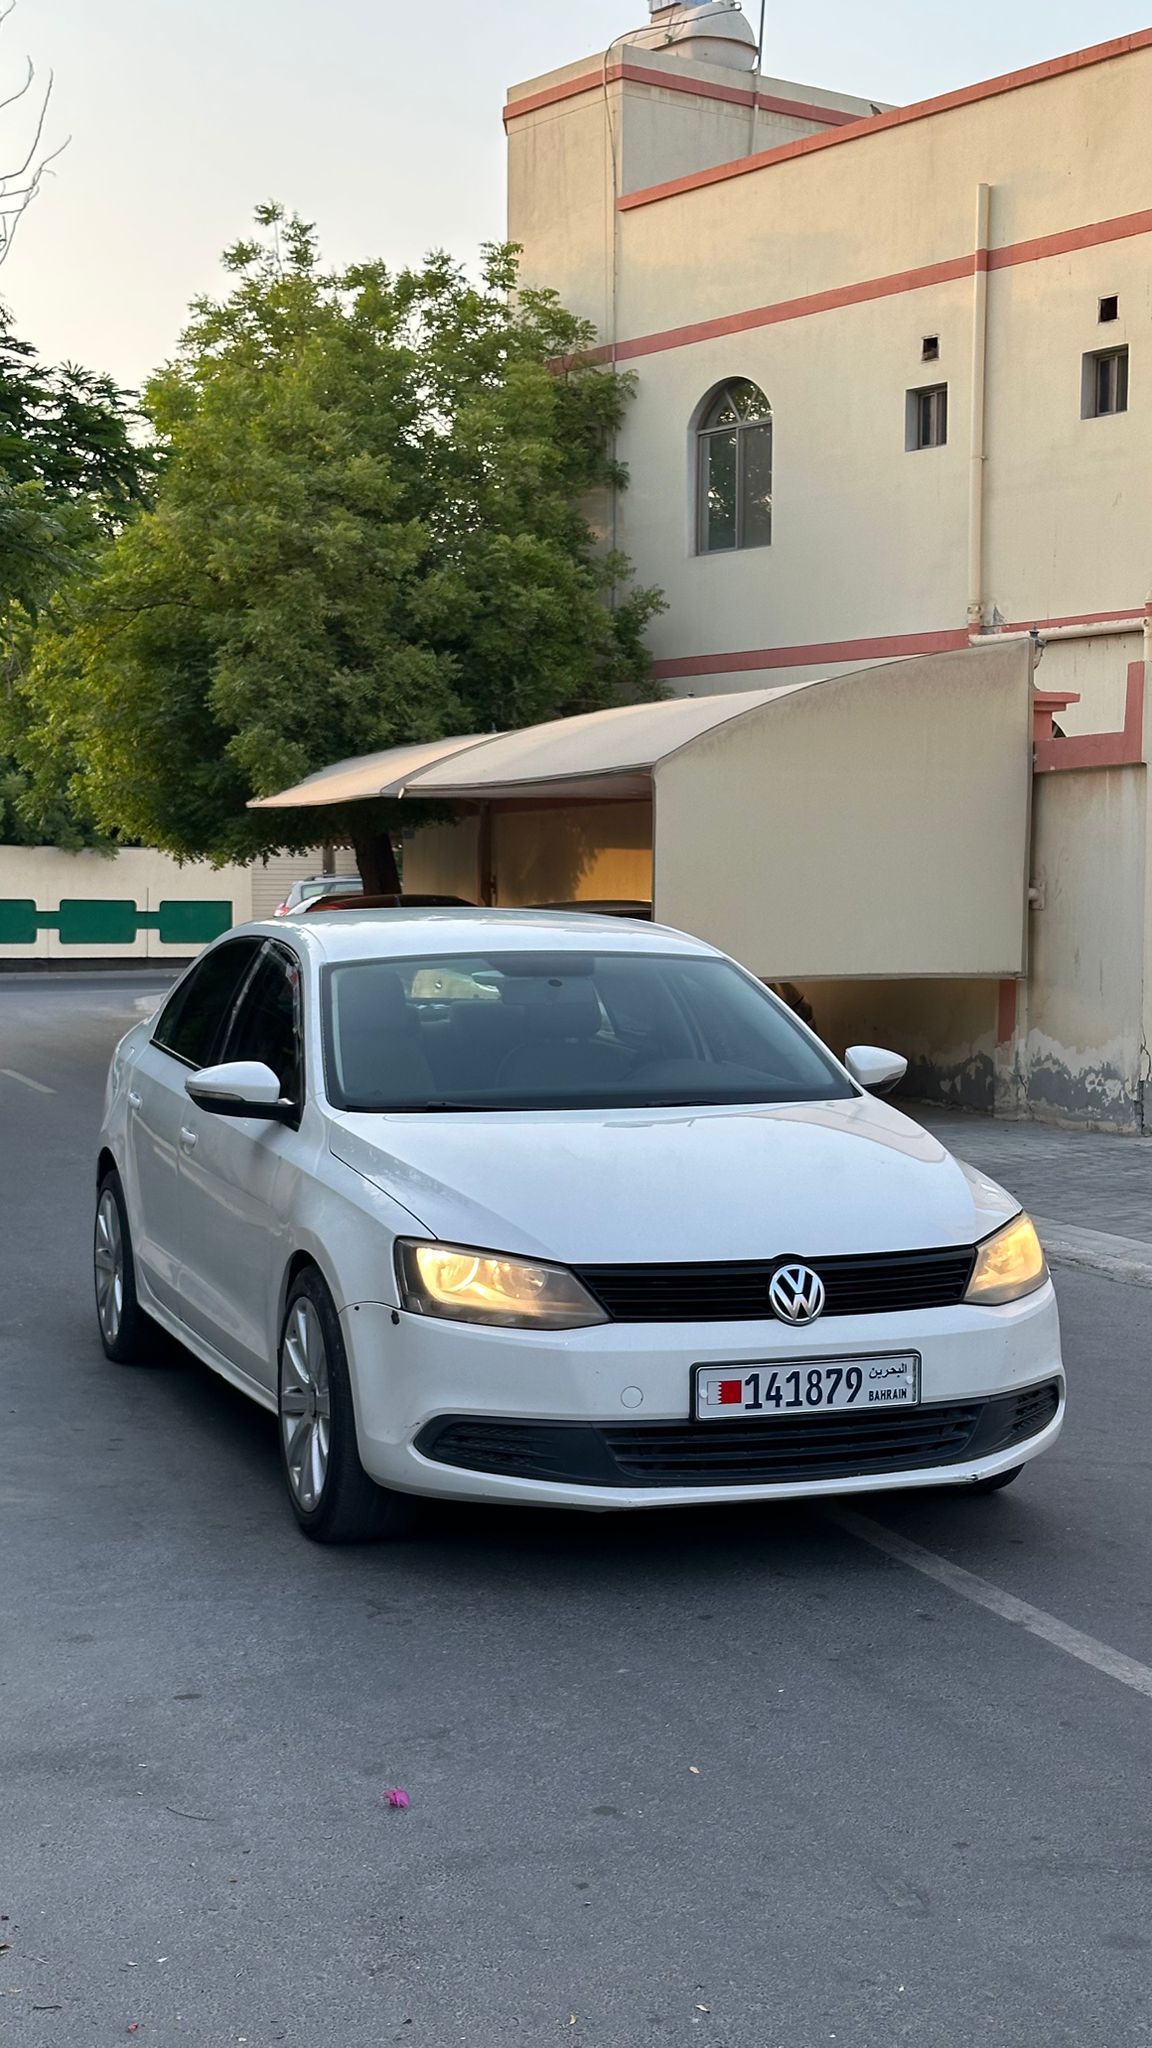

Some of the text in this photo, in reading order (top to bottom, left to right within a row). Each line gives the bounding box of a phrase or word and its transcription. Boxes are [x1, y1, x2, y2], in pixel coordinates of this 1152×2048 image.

[770, 1265, 823, 1322] VW
[869, 1363, 907, 1379] البحرين
[745, 1366, 863, 1410] 141879
[868, 1388, 907, 1402] BAHRAIN
